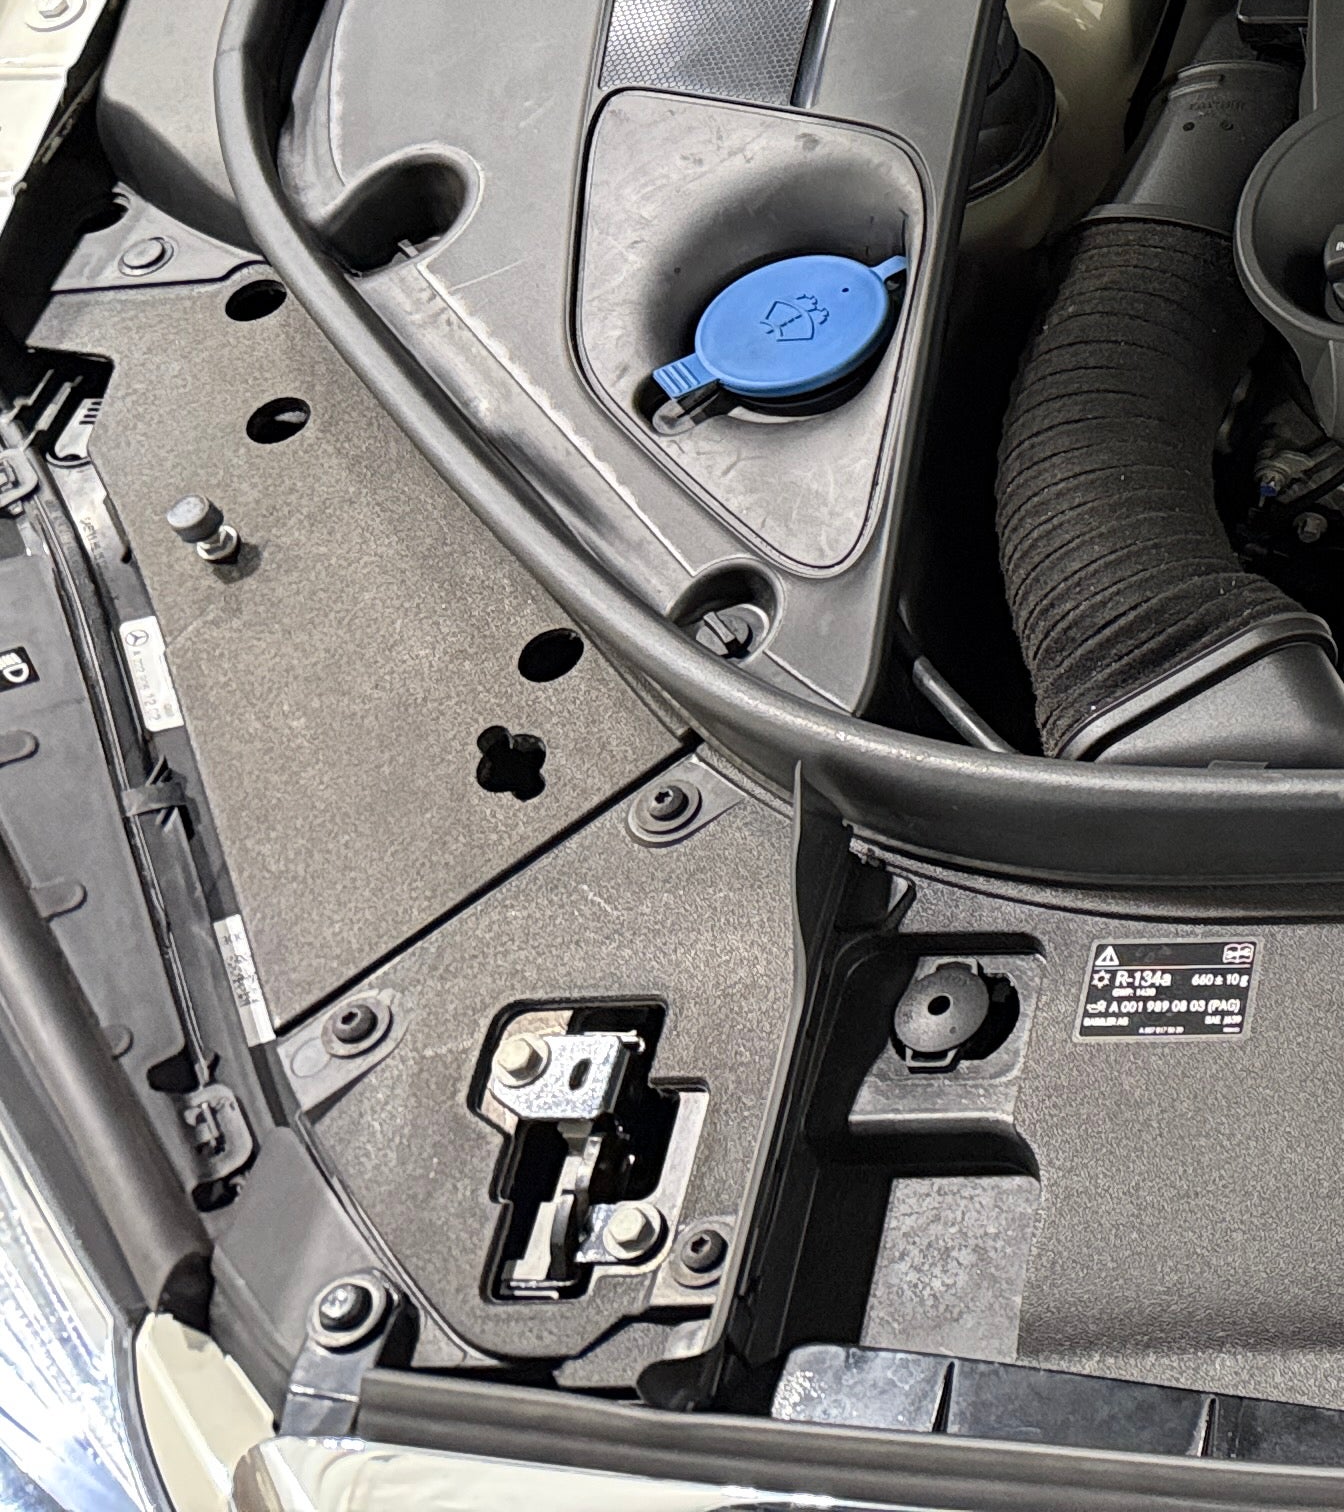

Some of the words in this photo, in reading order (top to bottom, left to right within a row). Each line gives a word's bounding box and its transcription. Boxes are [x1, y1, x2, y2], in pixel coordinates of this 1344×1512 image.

[1114, 970, 1172, 987] R-134a
[1191, 974, 1214, 986] 660
[1109, 1002, 1119, 1014] A
[1120, 1001, 1143, 1013] 001
[1146, 1001, 1170, 1013] 989
[1171, 1000, 1187, 1012] 08
[1190, 1000, 1205, 1012] 03
[1207, 999, 1241, 1014] (PAG)
